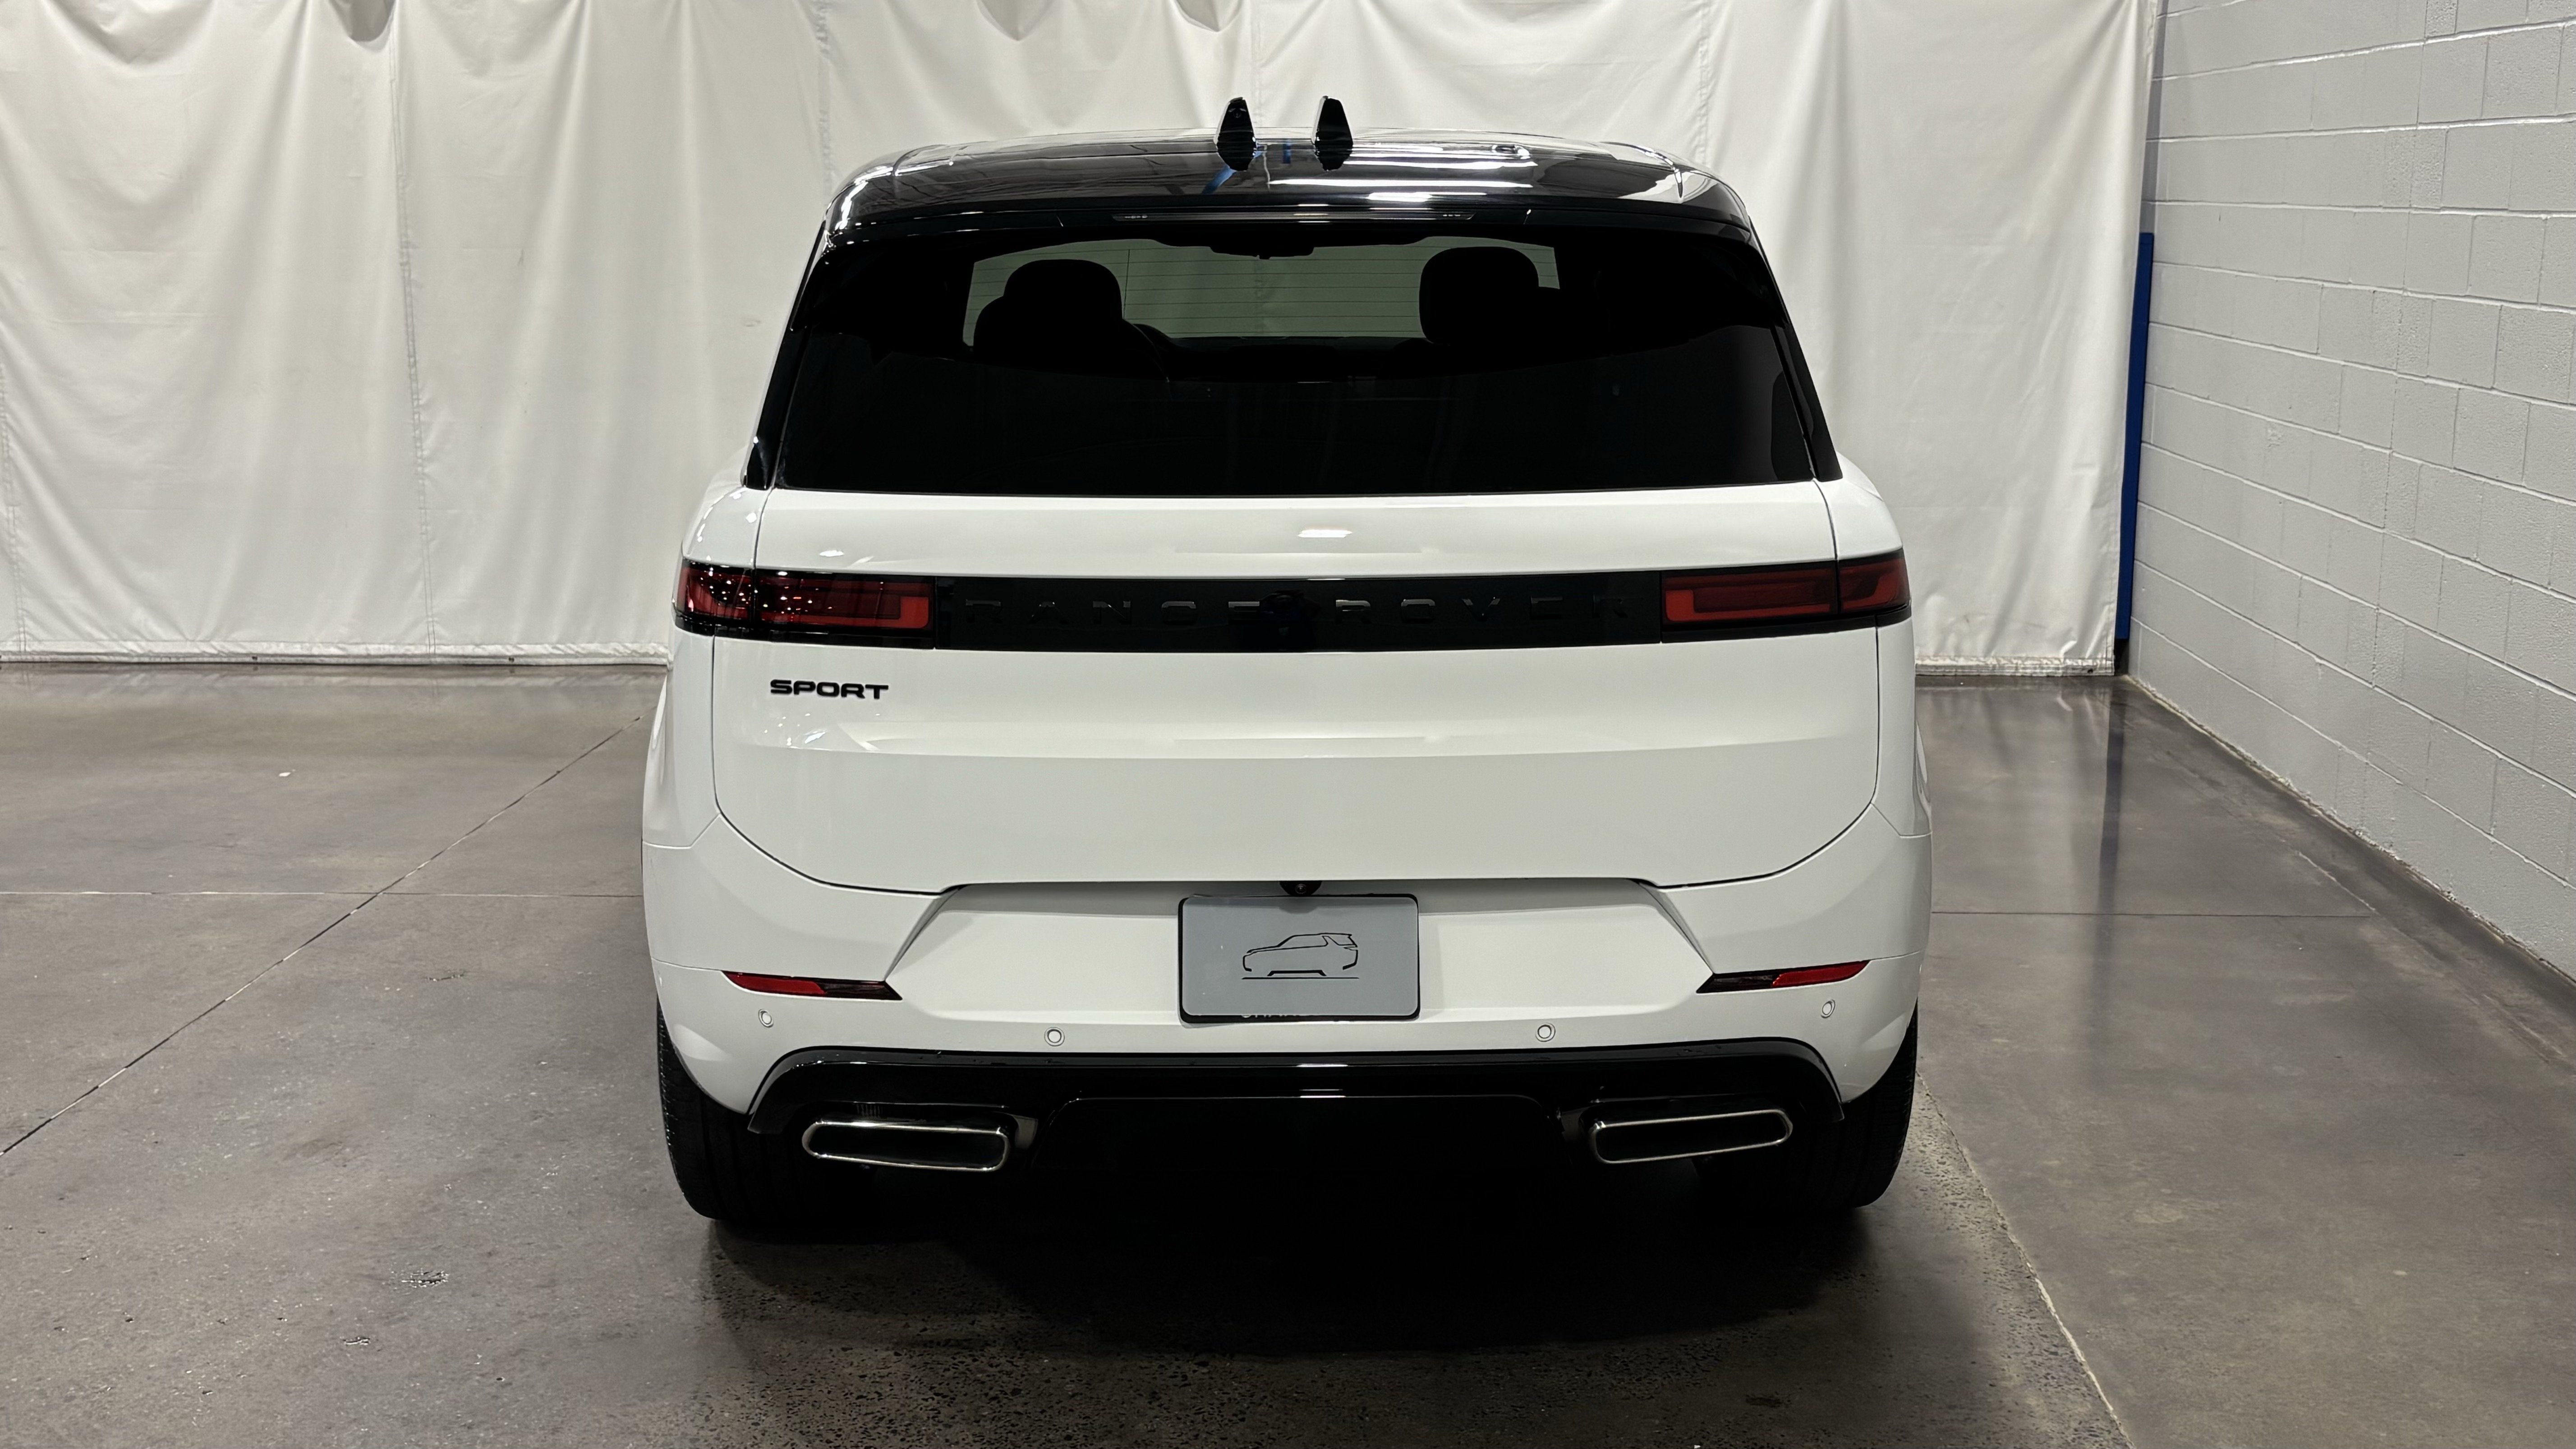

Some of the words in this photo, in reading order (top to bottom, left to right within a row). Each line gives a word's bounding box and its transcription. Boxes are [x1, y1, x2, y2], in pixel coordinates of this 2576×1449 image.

[965, 598, 1261, 624] RANGE
[1335, 593, 1628, 624] ROVER
[770, 679, 889, 699] SPORT
